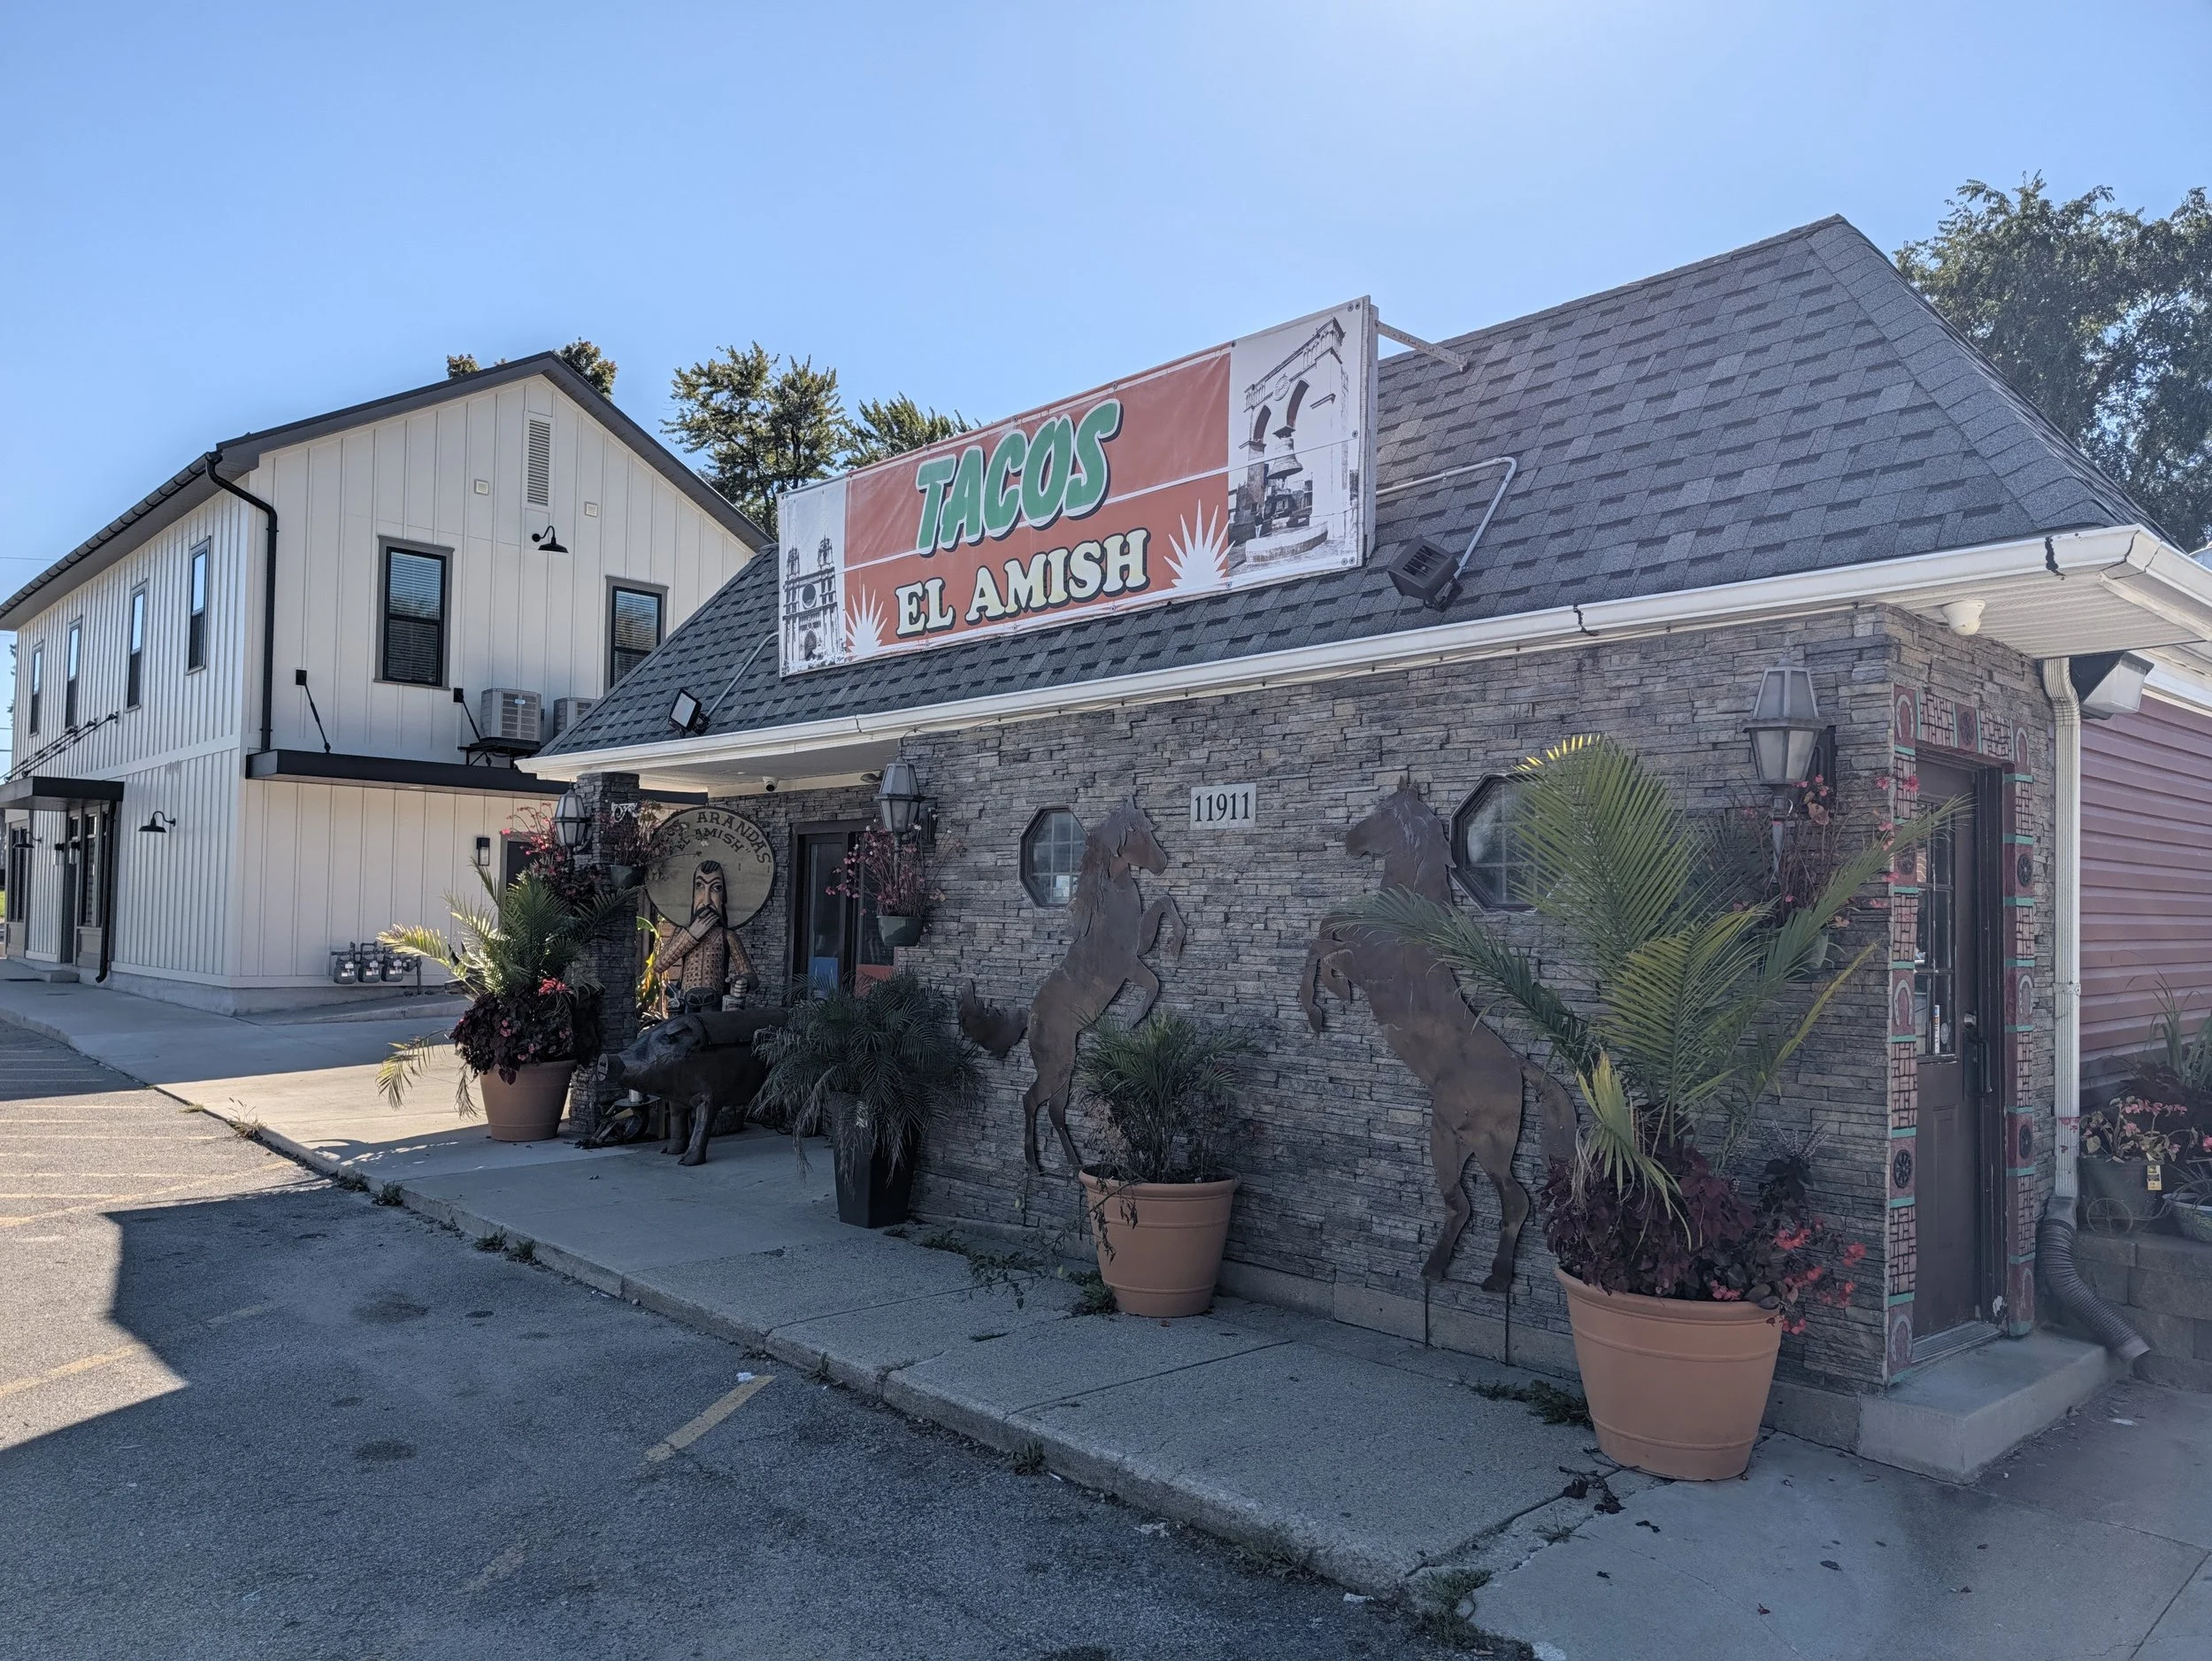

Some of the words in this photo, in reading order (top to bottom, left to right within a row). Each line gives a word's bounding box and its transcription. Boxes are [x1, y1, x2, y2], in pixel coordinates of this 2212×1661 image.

[916, 399, 1123, 558] TACOS
[895, 577, 956, 638] EL
[965, 527, 1151, 624] AMISH
[696, 811, 772, 864] ARANDAS
[1194, 791, 1250, 822] 11911
